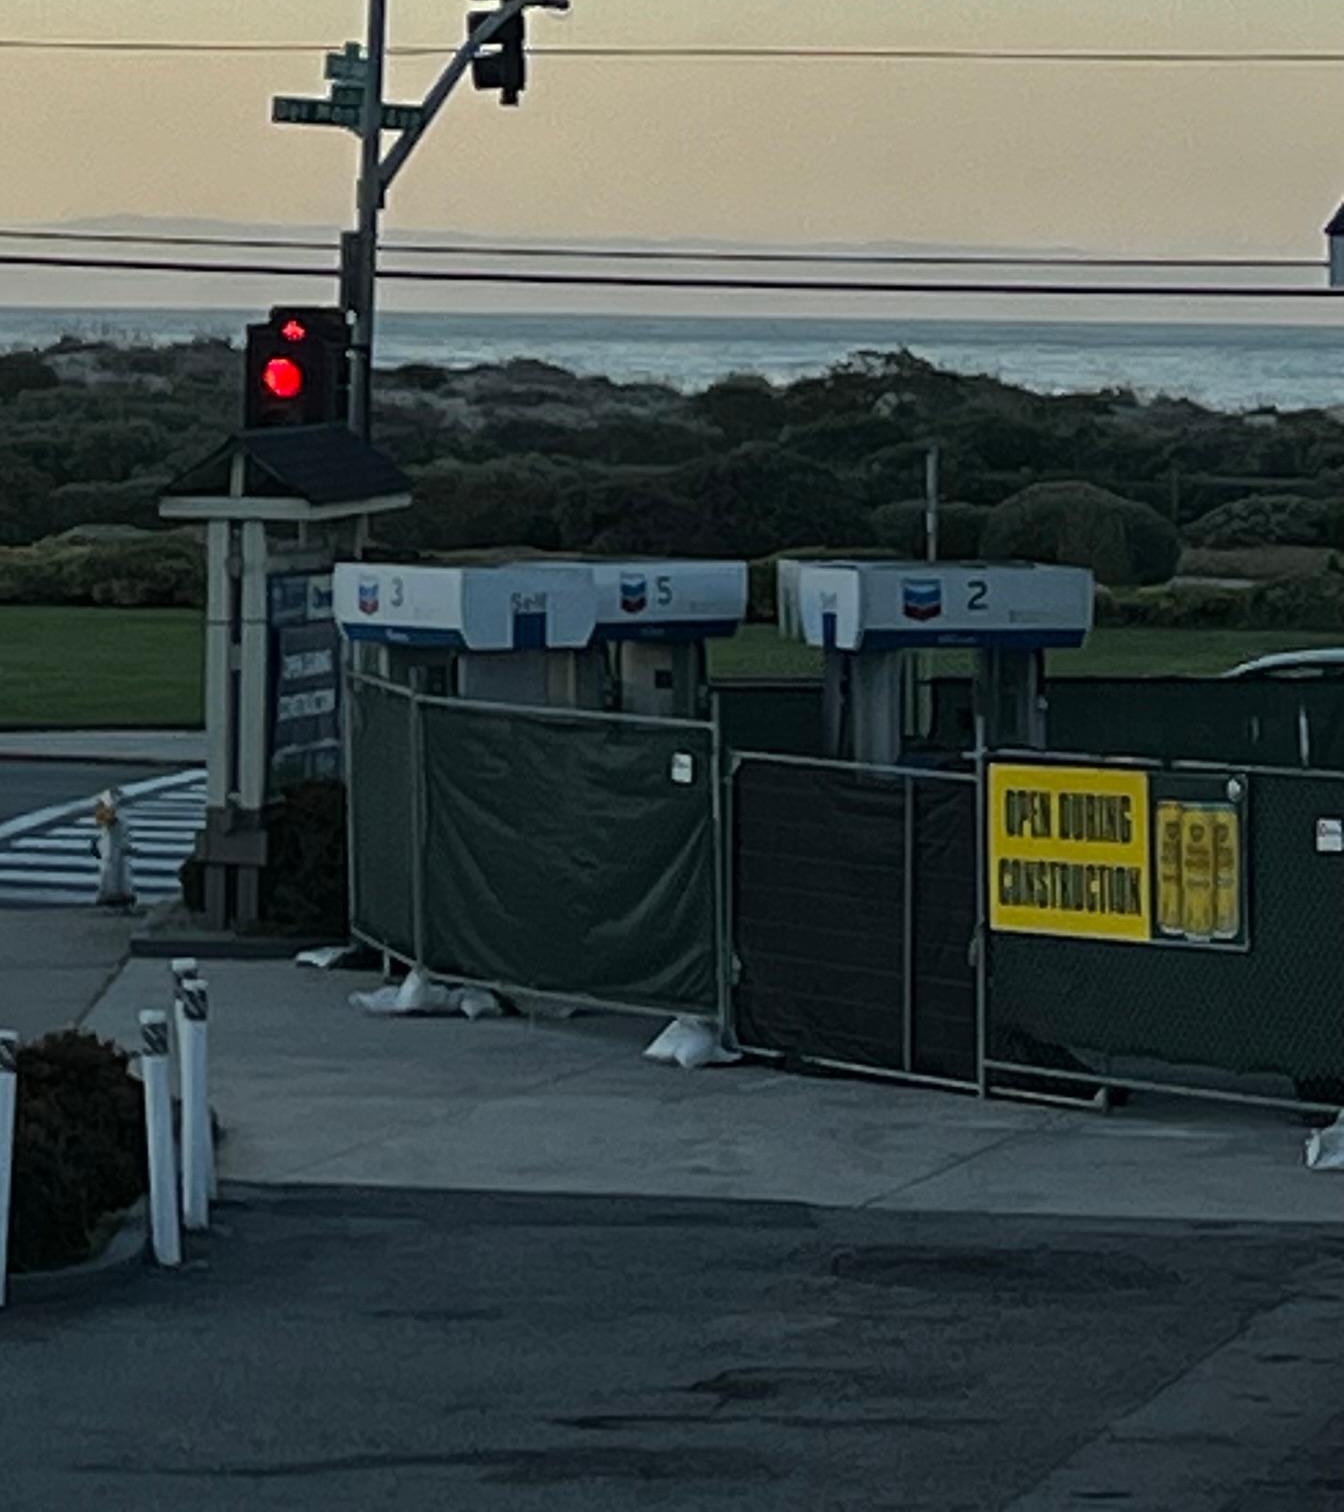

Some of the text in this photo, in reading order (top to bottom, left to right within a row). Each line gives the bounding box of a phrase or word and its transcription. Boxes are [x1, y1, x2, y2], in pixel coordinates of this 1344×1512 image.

[391, 577, 405, 608] 3
[657, 576, 673, 606] 5
[967, 581, 988, 610] 2
